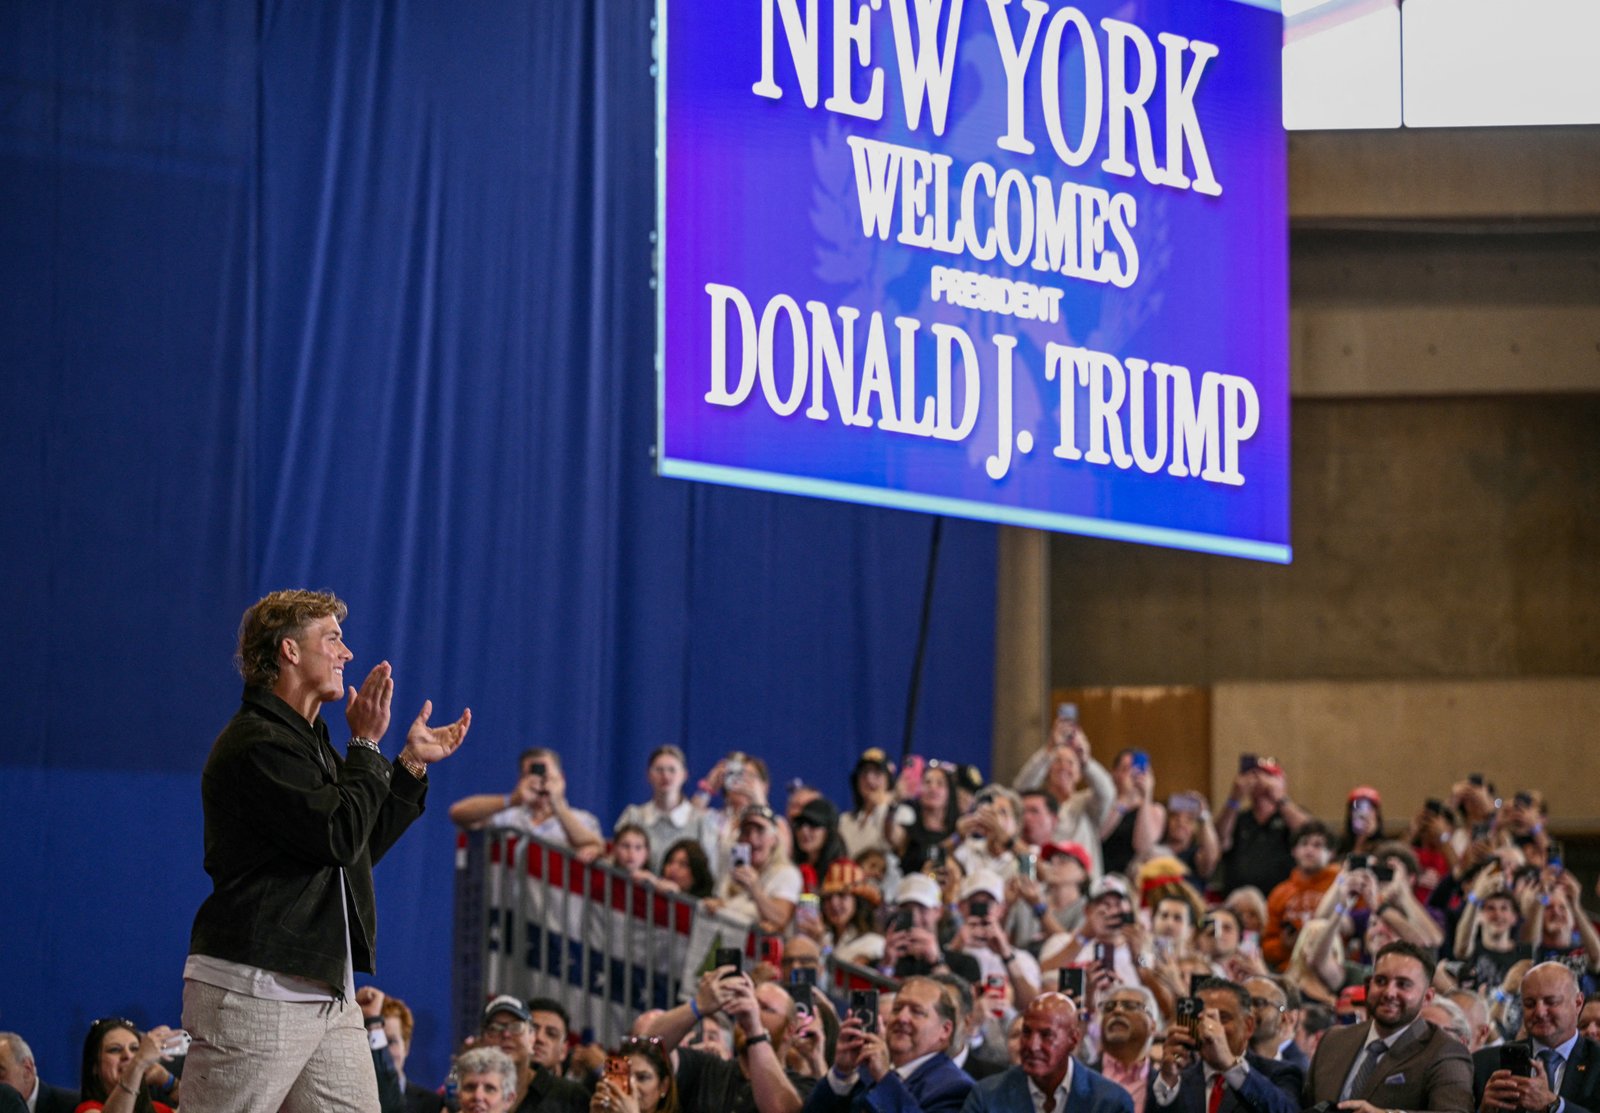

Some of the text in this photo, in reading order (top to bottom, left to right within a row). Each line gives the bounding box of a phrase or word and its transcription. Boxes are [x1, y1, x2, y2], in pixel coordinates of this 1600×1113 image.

[751, 0, 1223, 197] NEW YORK
[846, 135, 1140, 289] WELCOMES
[930, 265, 1065, 324] PRESIDENT
[704, 282, 1260, 487] DONALD J. TRUMP
